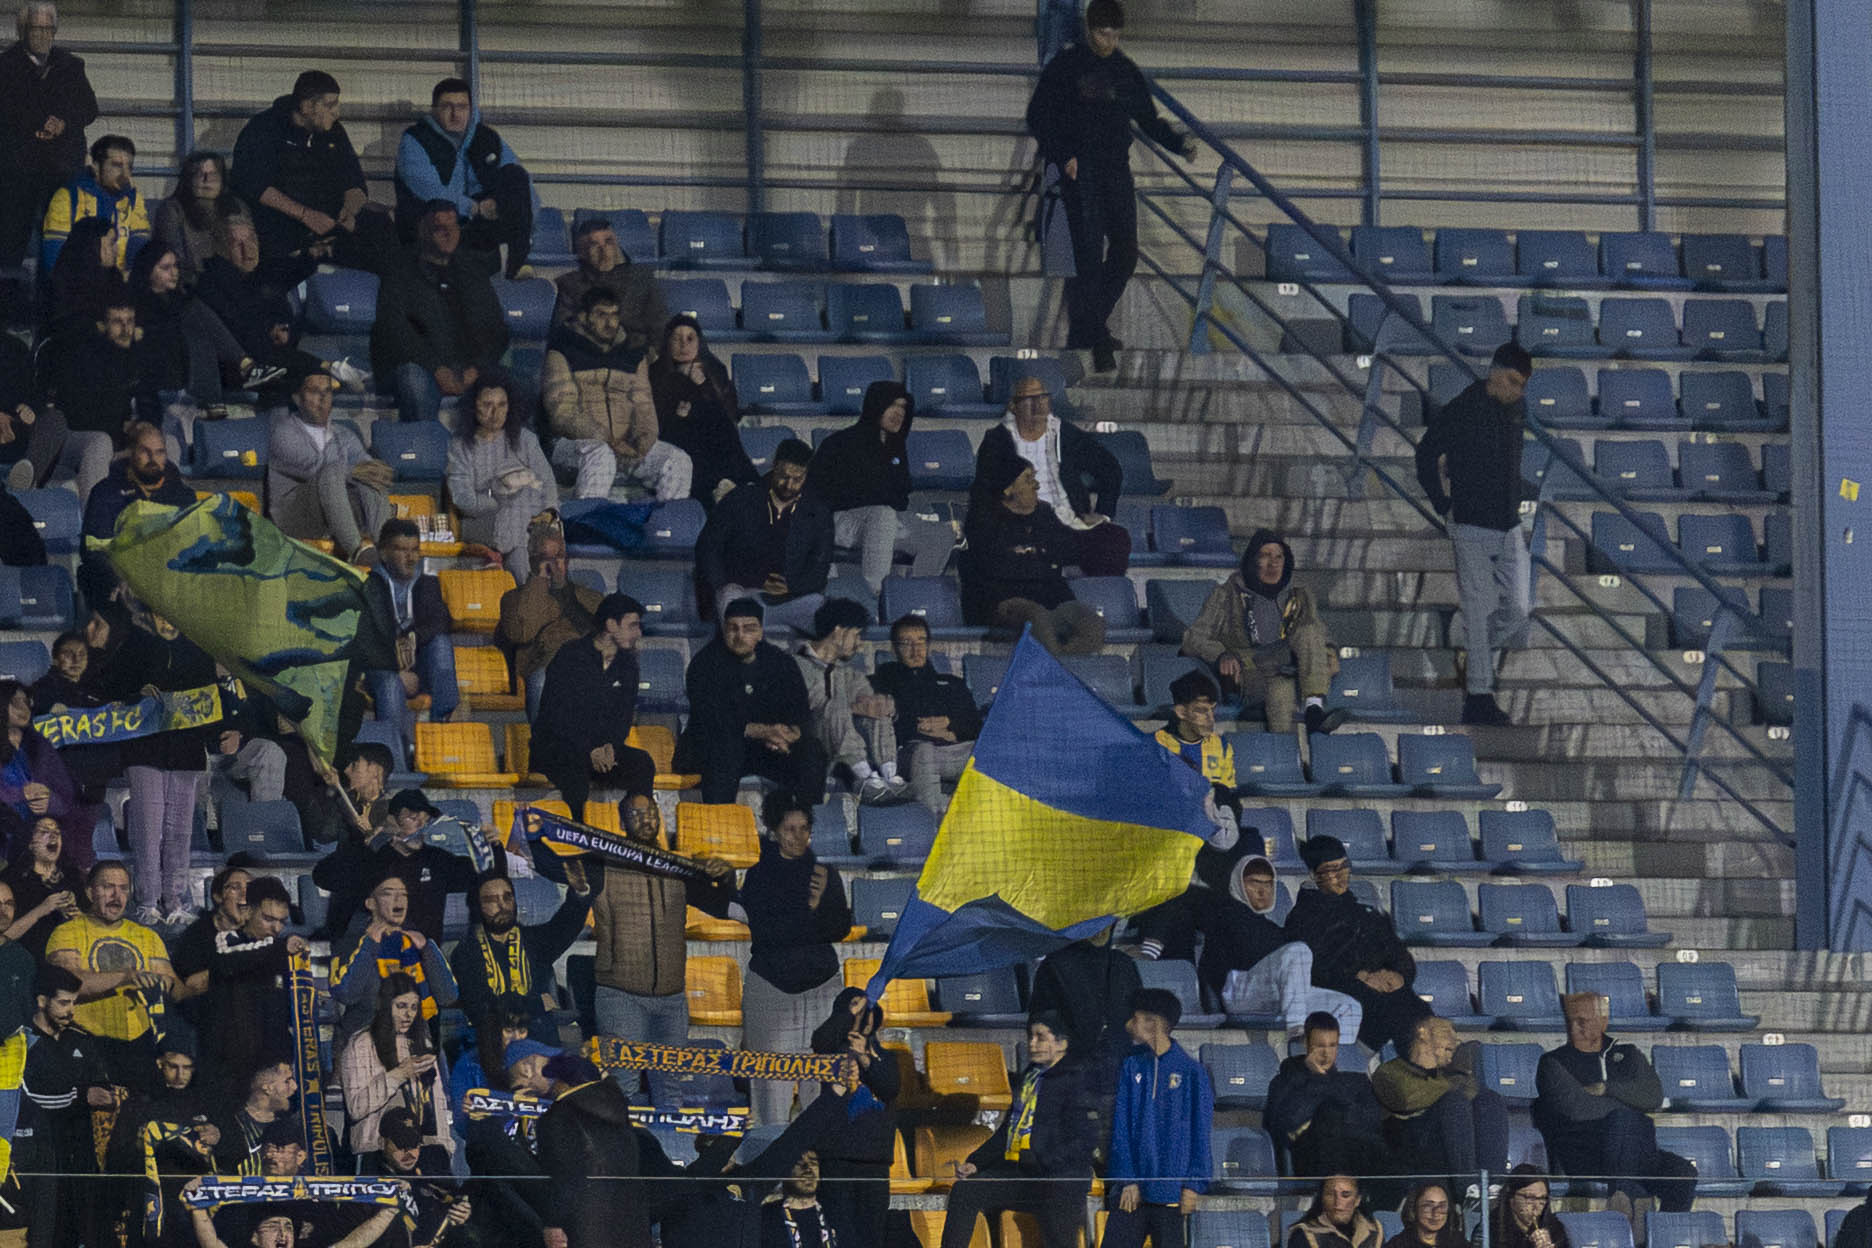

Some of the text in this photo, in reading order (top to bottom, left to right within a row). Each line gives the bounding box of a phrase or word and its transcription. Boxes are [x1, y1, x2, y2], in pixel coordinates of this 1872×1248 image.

[556, 827, 589, 846] UEFA
[591, 836, 643, 862] EUROPA
[619, 1044, 722, 1070] ΑΣΤΕΡΑΣ
[187, 1184, 290, 1200] ΣΤΕΡΑΣ
